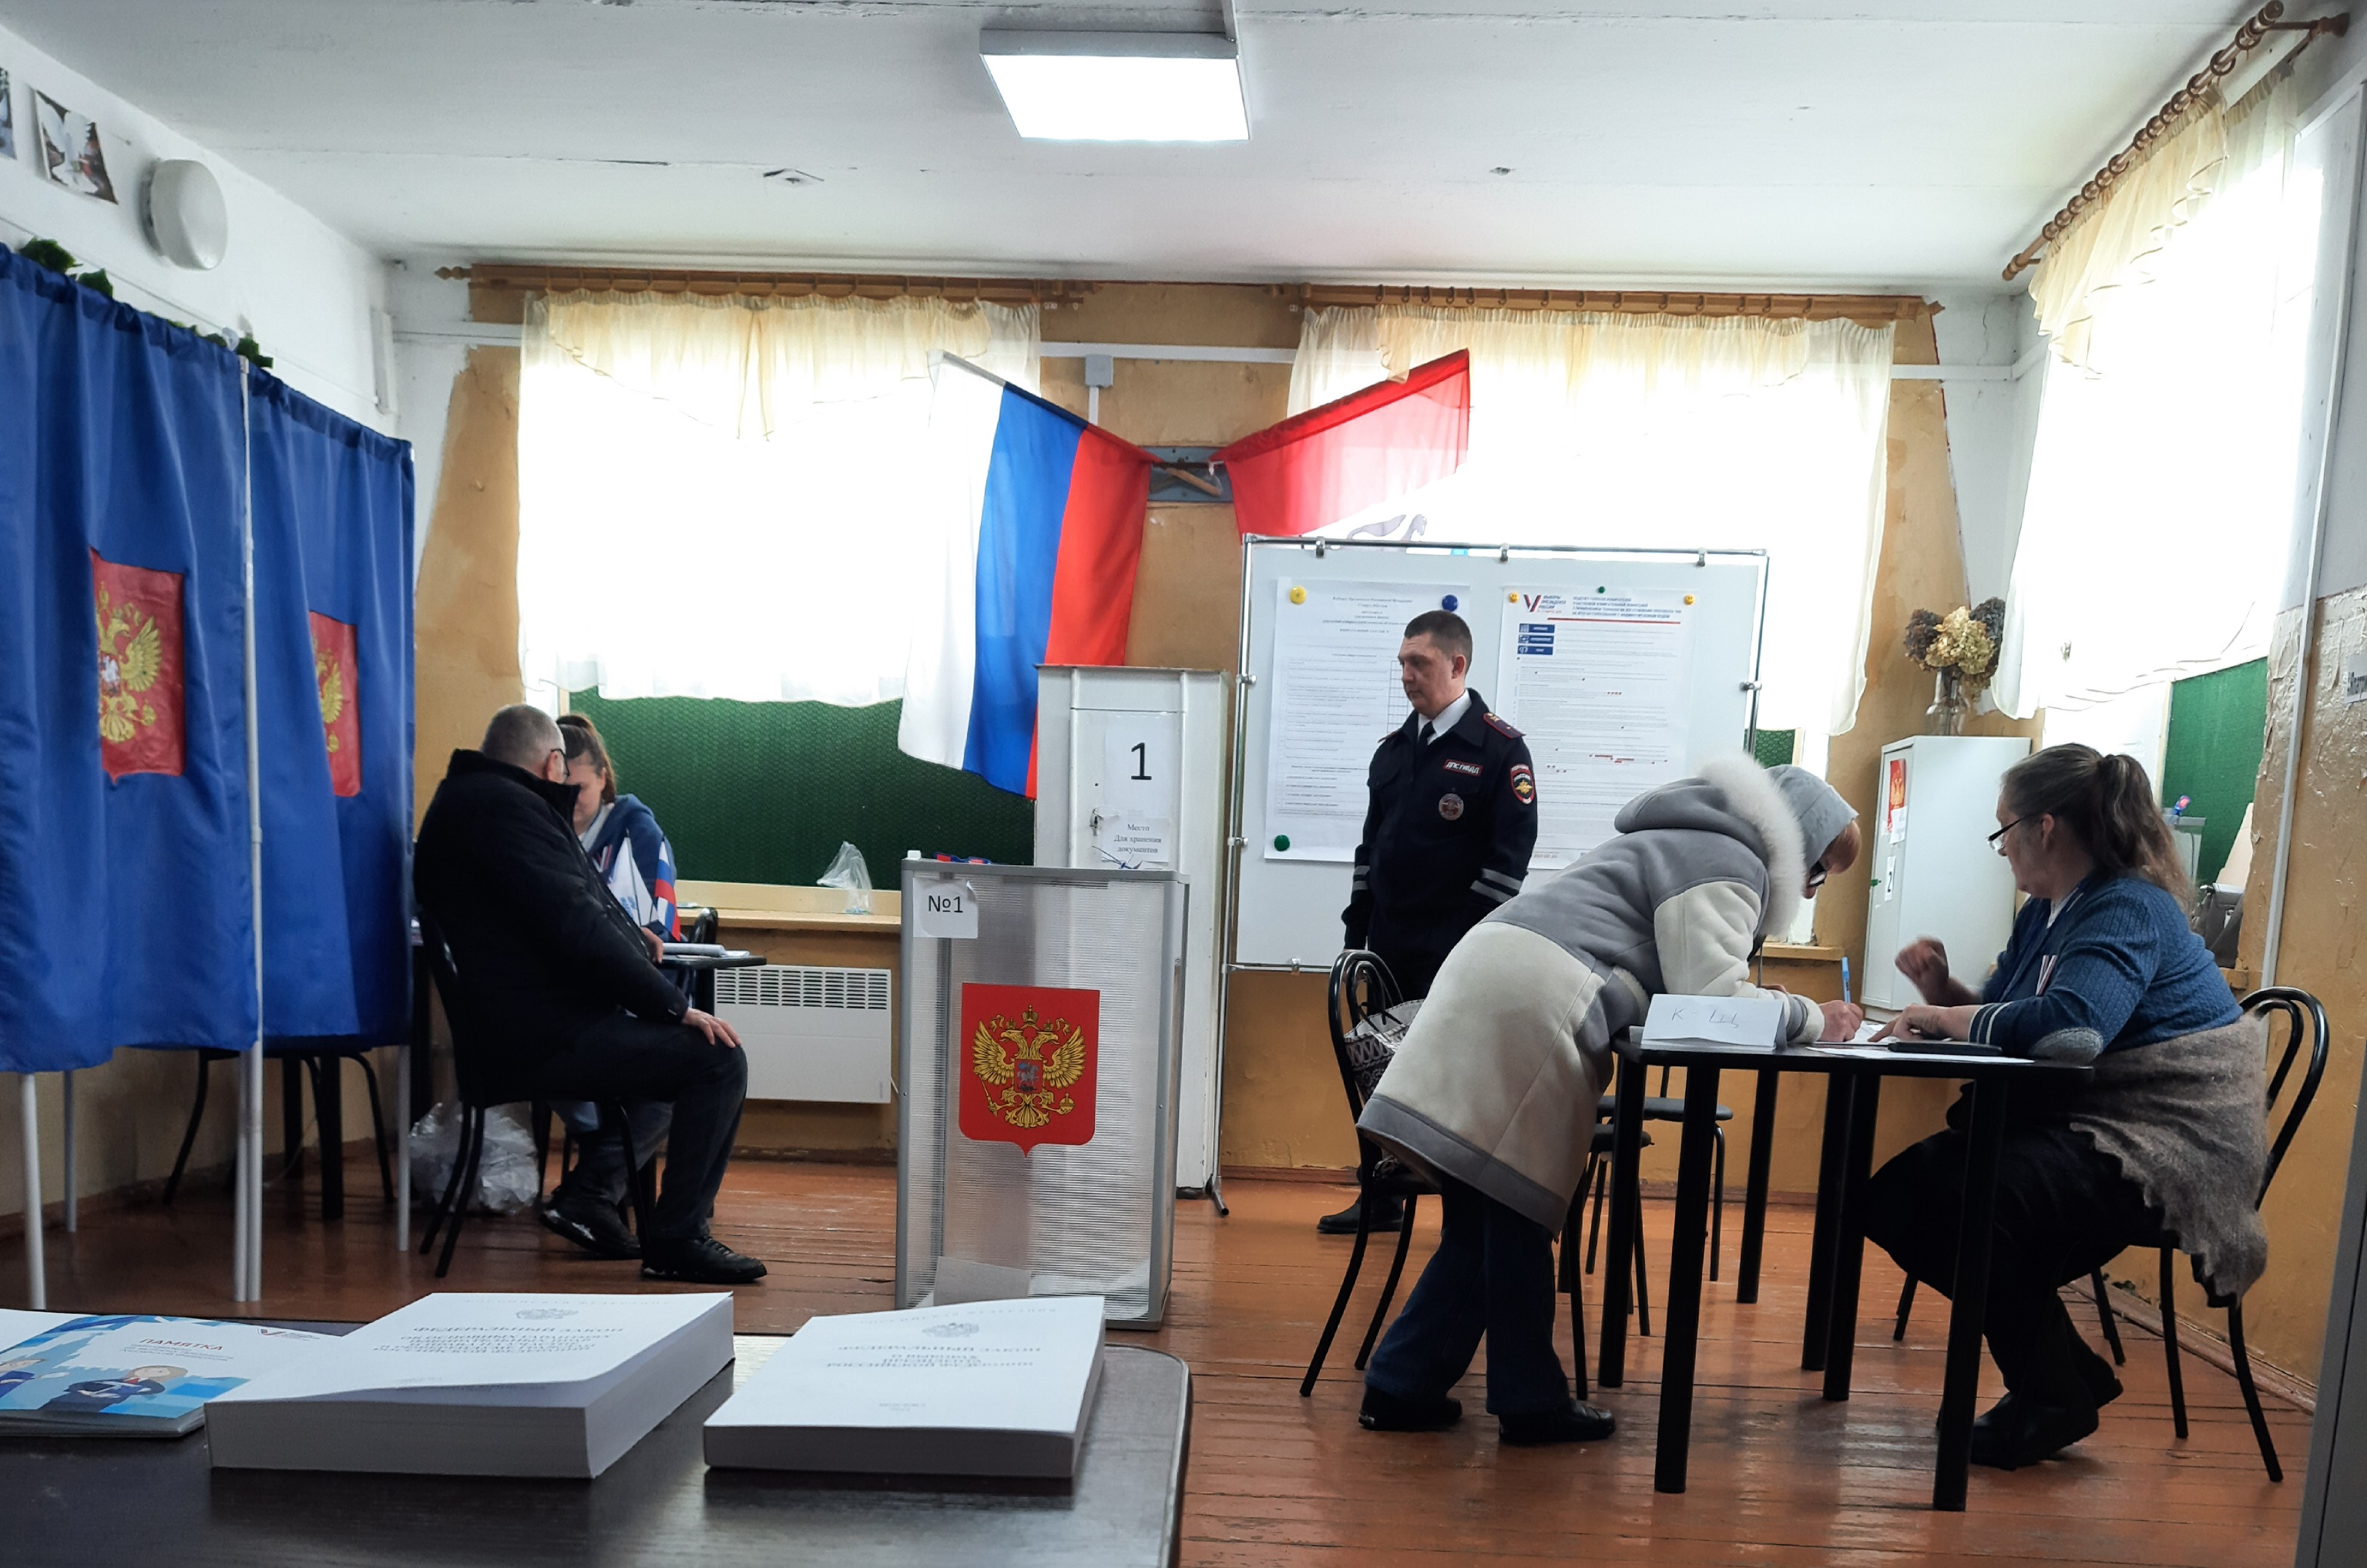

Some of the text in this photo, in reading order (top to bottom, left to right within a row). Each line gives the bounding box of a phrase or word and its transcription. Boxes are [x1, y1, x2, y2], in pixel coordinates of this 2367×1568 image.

[1130, 742, 1152, 781] 1
[1127, 823, 1150, 831] Место
[1113, 834, 1127, 843] Для
[928, 895, 964, 913] №1
[139, 1338, 223, 1351] ПАМЯТКА
